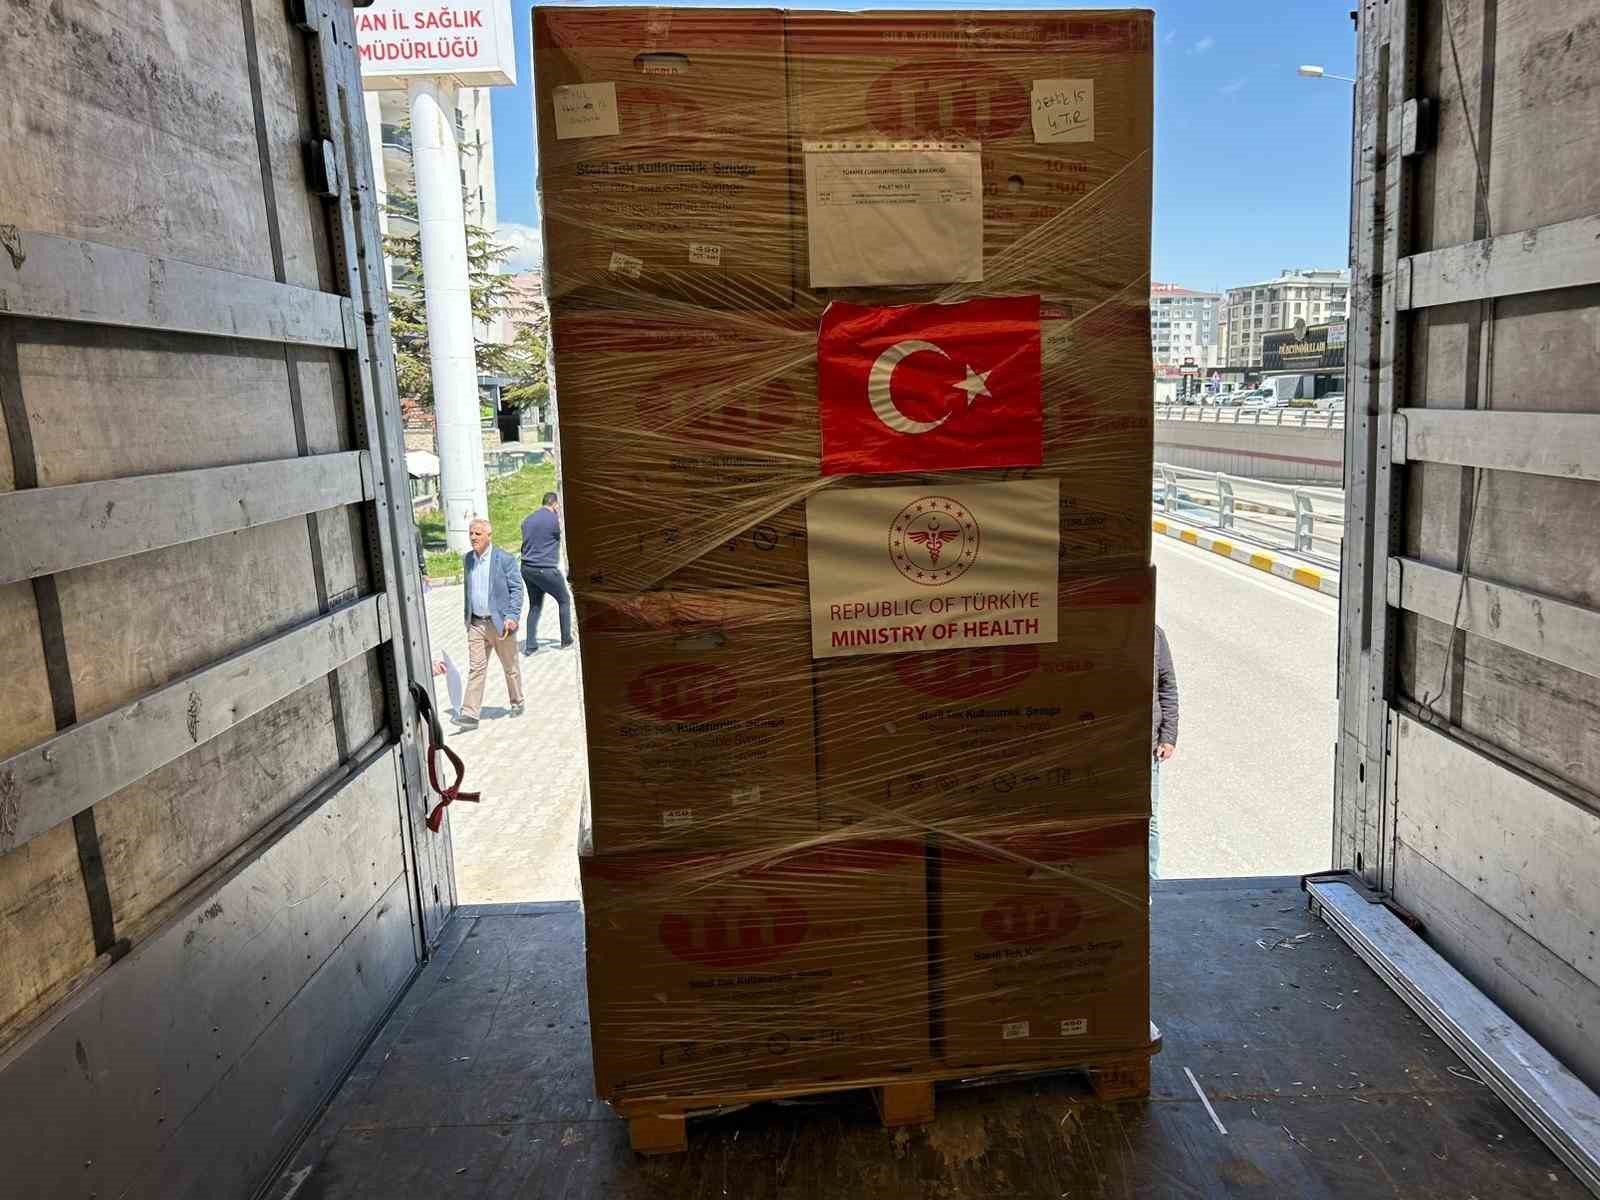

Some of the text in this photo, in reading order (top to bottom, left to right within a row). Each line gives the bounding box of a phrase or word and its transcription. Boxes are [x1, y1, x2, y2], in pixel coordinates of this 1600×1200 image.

[392, 9, 409, 30] İL
[415, 6, 482, 29] SAĞLIK
[358, 36, 479, 61] MÜDÜRLÜĞÜ
[830, 589, 1040, 621] REPUBLIC OF TÜRKİYE
[831, 618, 1040, 648] MINISTRY OF HEALTH
